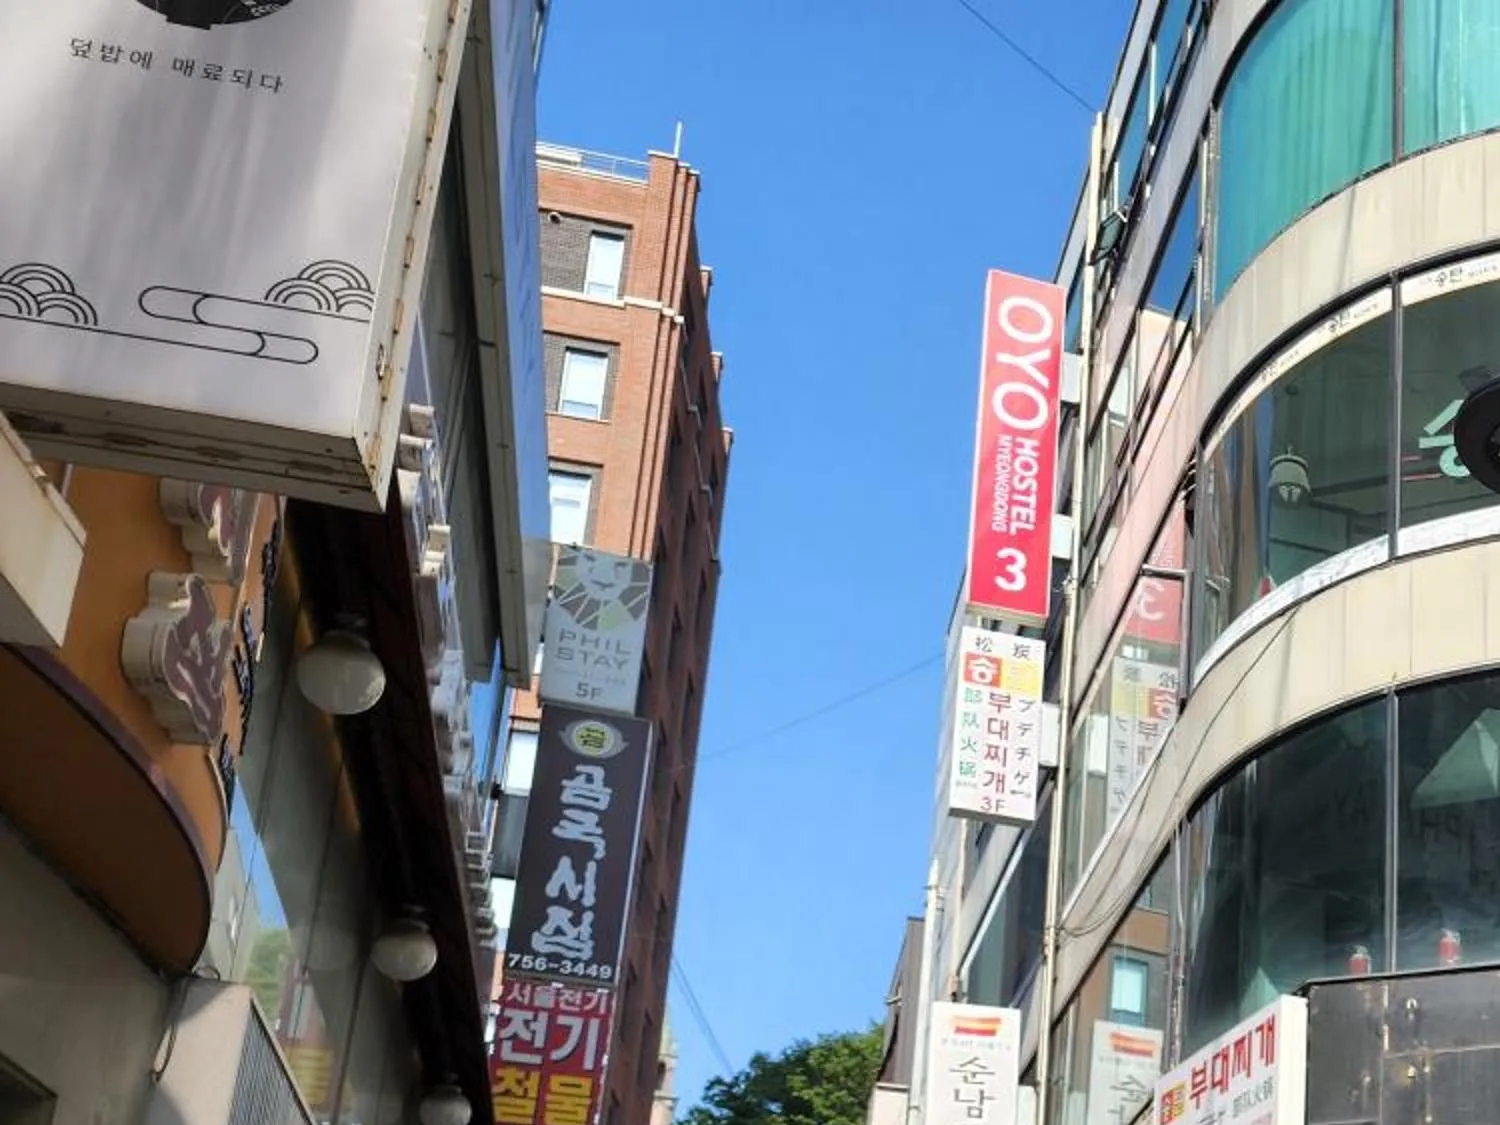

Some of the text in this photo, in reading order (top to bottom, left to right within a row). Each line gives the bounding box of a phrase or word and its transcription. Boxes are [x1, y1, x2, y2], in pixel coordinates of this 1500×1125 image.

[992, 295, 1053, 430] OYO
[991, 434, 1013, 532] MYEONGDONG
[1009, 436, 1040, 537] HOSTEL
[995, 547, 1027, 592] 3
[554, 646, 629, 670] STAY
[558, 627, 632, 655] PHIL
[575, 681, 605, 701] 5F
[980, 691, 1013, 795] 부대찌개
[506, 953, 612, 979] 756-3449
[499, 1007, 600, 1071] 전기
[1189, 1013, 1276, 1110] 부대찌개
